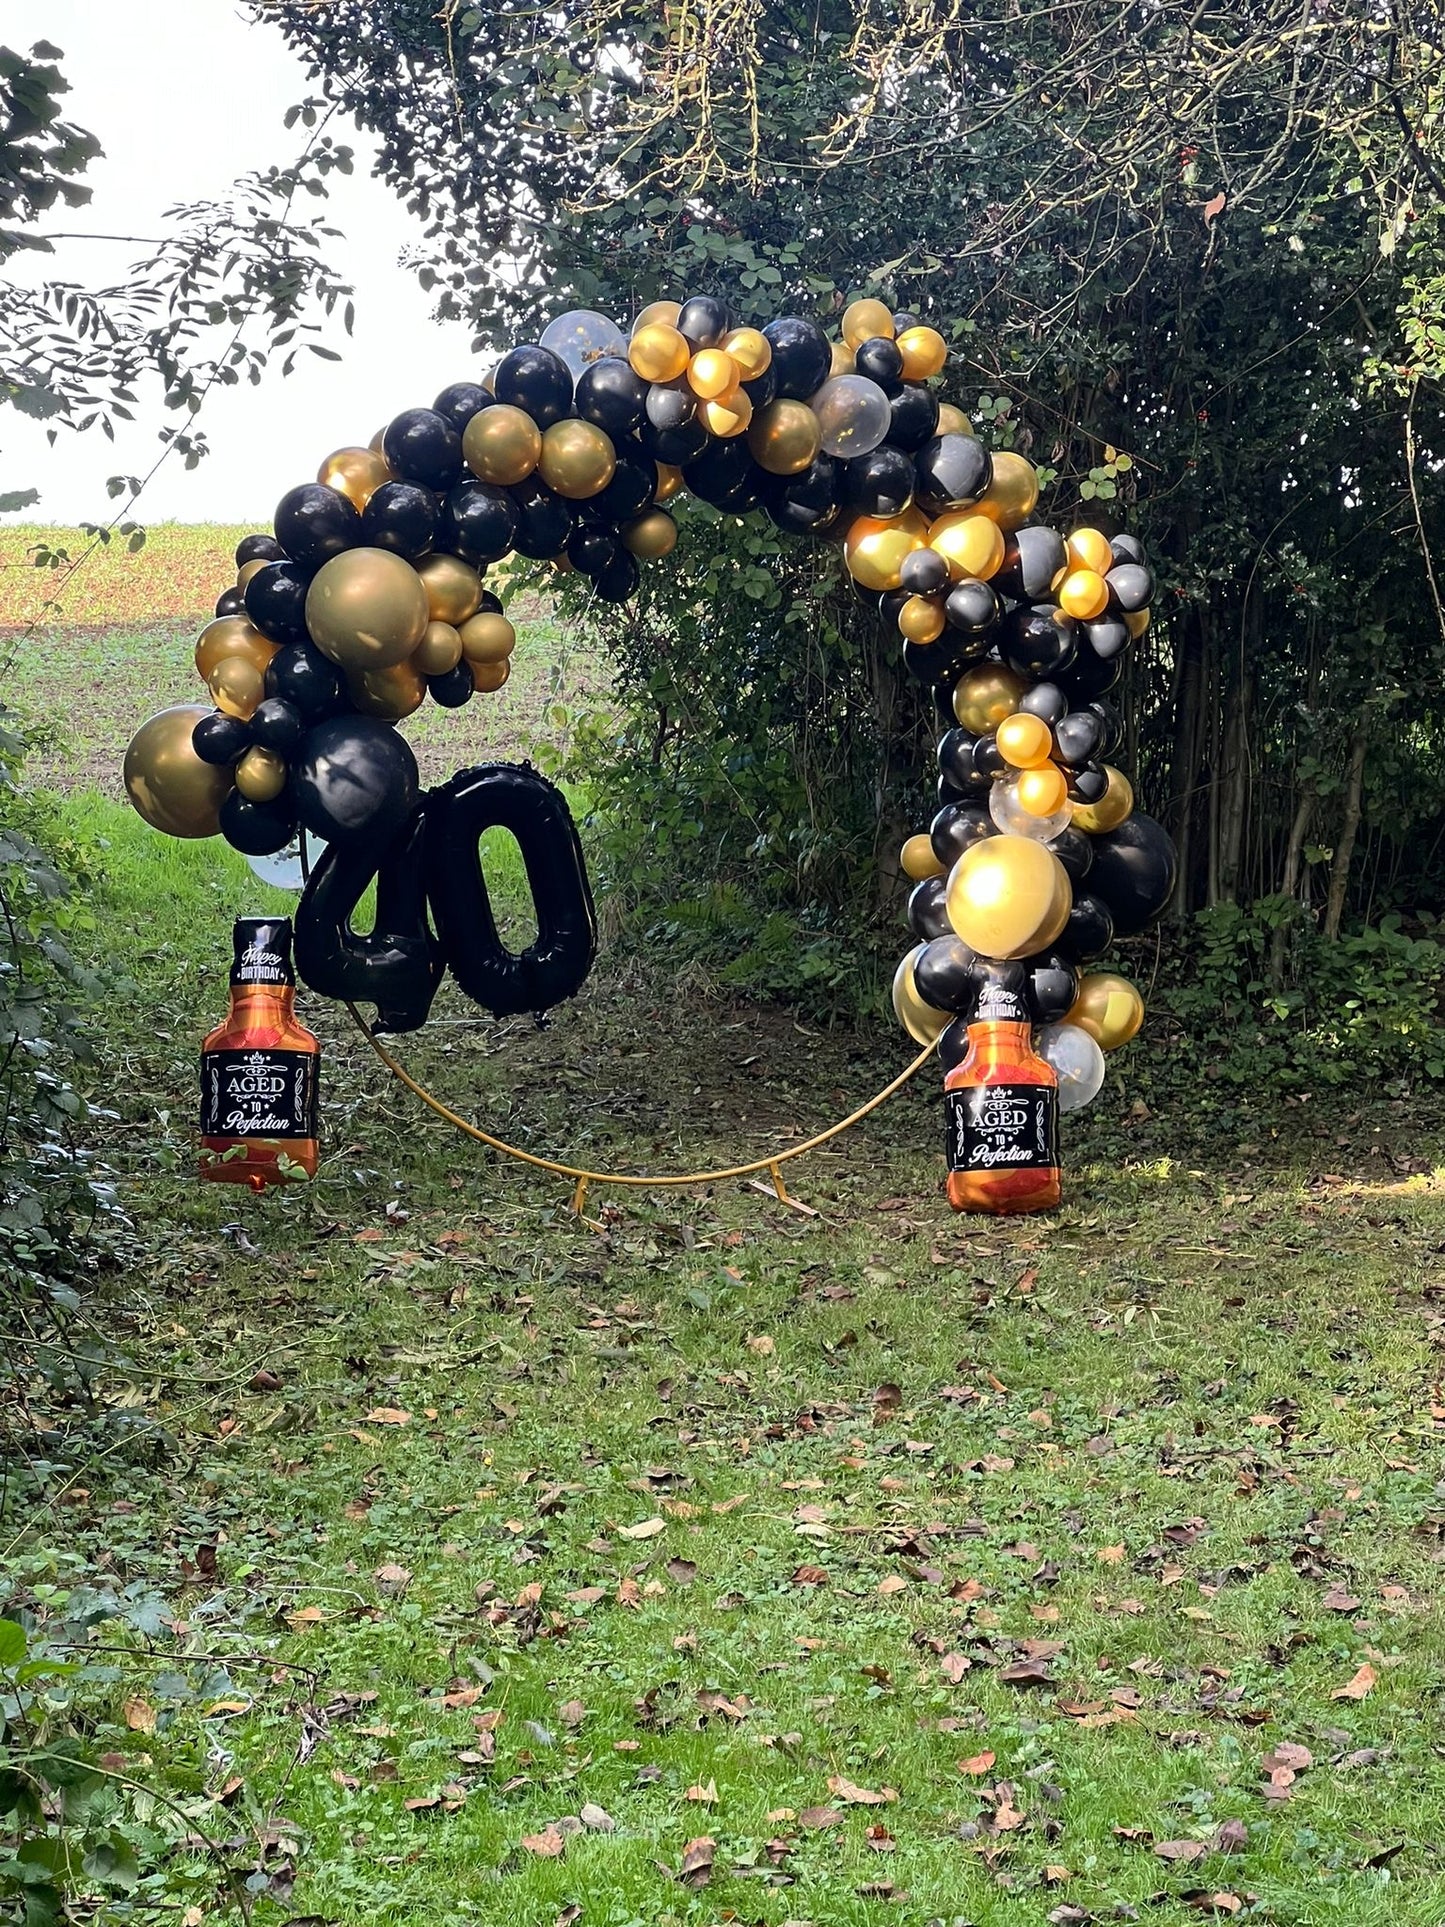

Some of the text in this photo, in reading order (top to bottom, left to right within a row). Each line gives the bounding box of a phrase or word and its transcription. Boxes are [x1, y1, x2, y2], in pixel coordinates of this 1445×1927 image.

[295, 758, 598, 1036] 40
[241, 945, 282, 967] Happy
[241, 966, 280, 980] BIRTHDAY
[978, 984, 1018, 1006] Happy
[978, 1004, 1017, 1019] BIRTHDAY
[226, 1077, 286, 1093] AGED
[250, 1101, 262, 1113] TO
[222, 1110, 290, 1135] Perfection
[971, 1110, 1028, 1127] AGED
[995, 1134, 1006, 1146] TO
[968, 1143, 1033, 1168] Perfection
